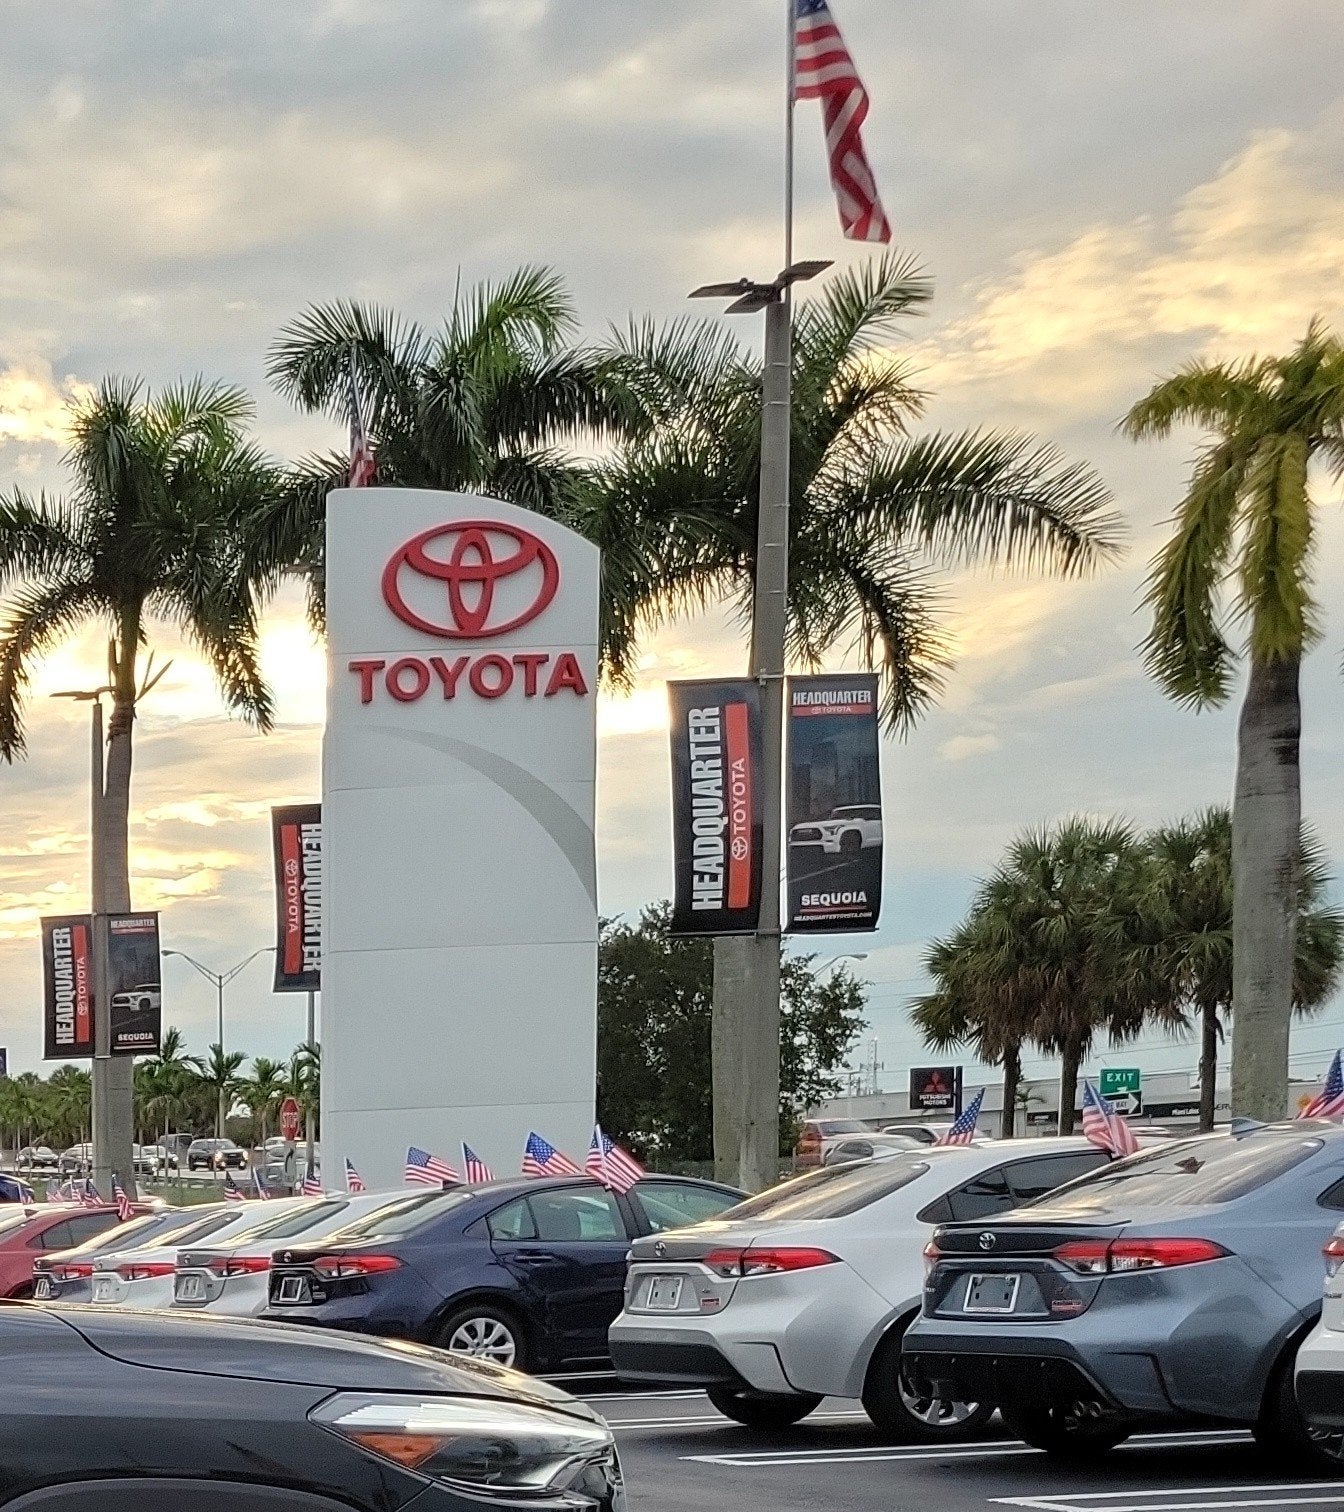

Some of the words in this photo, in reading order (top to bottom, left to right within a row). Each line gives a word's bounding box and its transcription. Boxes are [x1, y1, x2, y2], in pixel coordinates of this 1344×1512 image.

[348, 652, 589, 704] TOYOTA
[793, 689, 871, 706] HEADQUARTER
[688, 706, 729, 911] HEADQUARTER
[731, 757, 747, 835] TOYOTA
[286, 877, 300, 933] TOYOTA
[801, 891, 868, 906] SEQUOIA
[52, 927, 76, 1045] HEADQUARTER
[76, 956, 87, 1004] TOYOTA
[1106, 1072, 1135, 1083] EXIT
